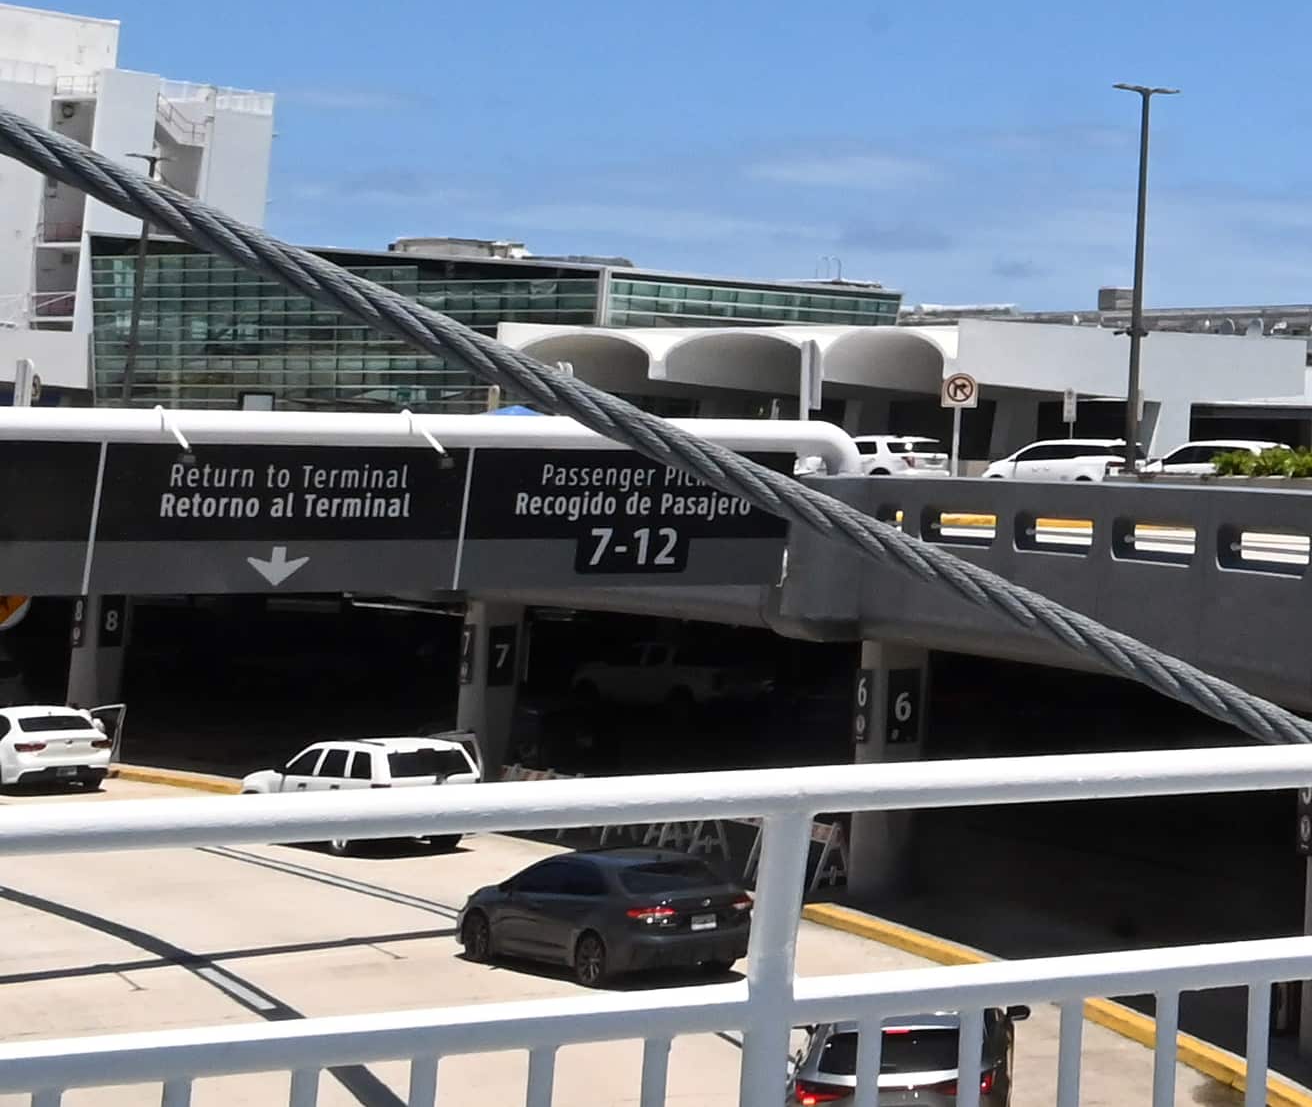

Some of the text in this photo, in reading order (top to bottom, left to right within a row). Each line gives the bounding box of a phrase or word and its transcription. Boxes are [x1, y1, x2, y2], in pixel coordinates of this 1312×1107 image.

[170, 463, 408, 489] Return to Terminal
[541, 464, 656, 492] Passenger
[159, 492, 410, 518] Retorno al Terminal
[515, 491, 751, 521] Recogido de Pasajero
[589, 527, 678, 566] 7-12
[105, 610, 119, 632] 8
[495, 643, 510, 669] 7
[857, 677, 868, 708] 6
[894, 691, 912, 722] 6
